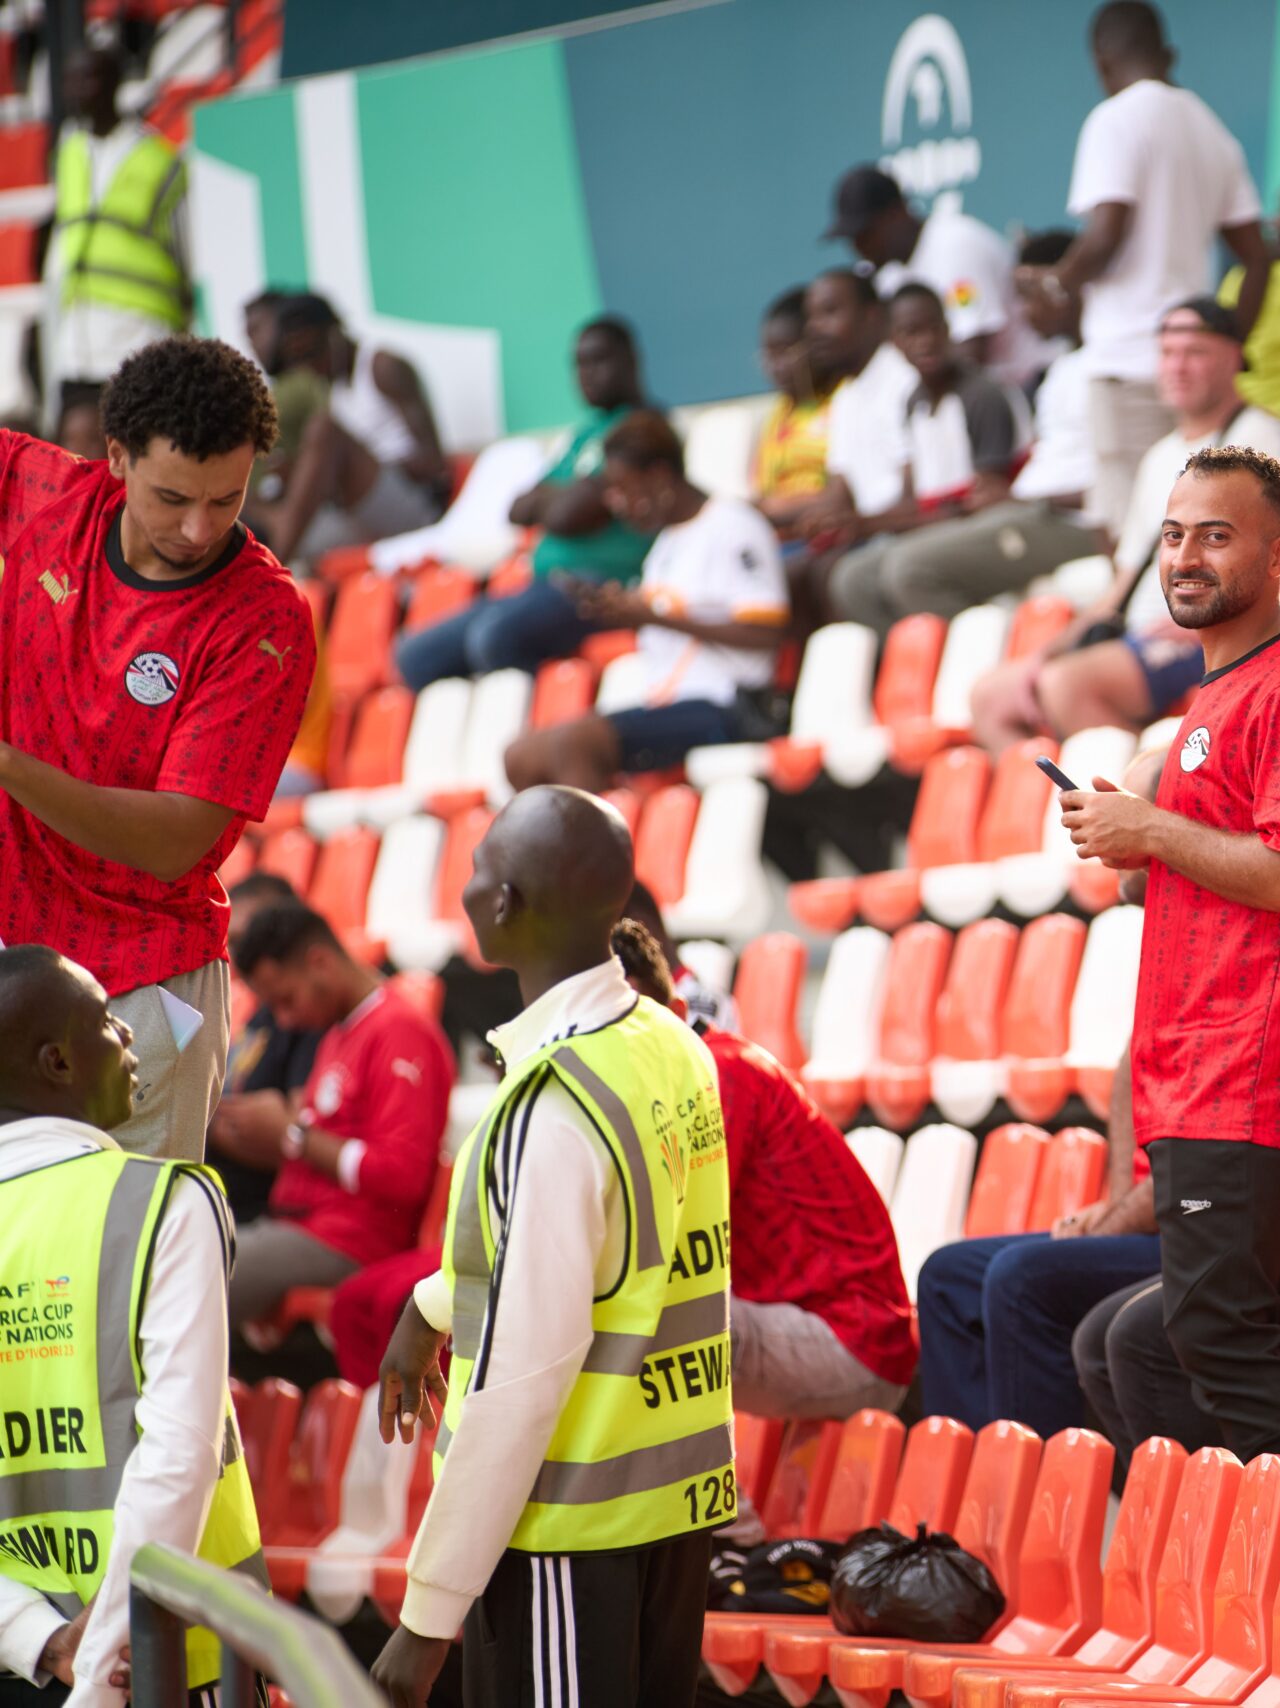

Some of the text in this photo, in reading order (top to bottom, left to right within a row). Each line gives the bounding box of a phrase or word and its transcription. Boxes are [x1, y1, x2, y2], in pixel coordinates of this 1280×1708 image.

[43, 1303, 73, 1322] CUP
[6, 1323, 73, 1345] NATIONS
[0, 1407, 87, 1459] DIER
[684, 1469, 736, 1525] 128
